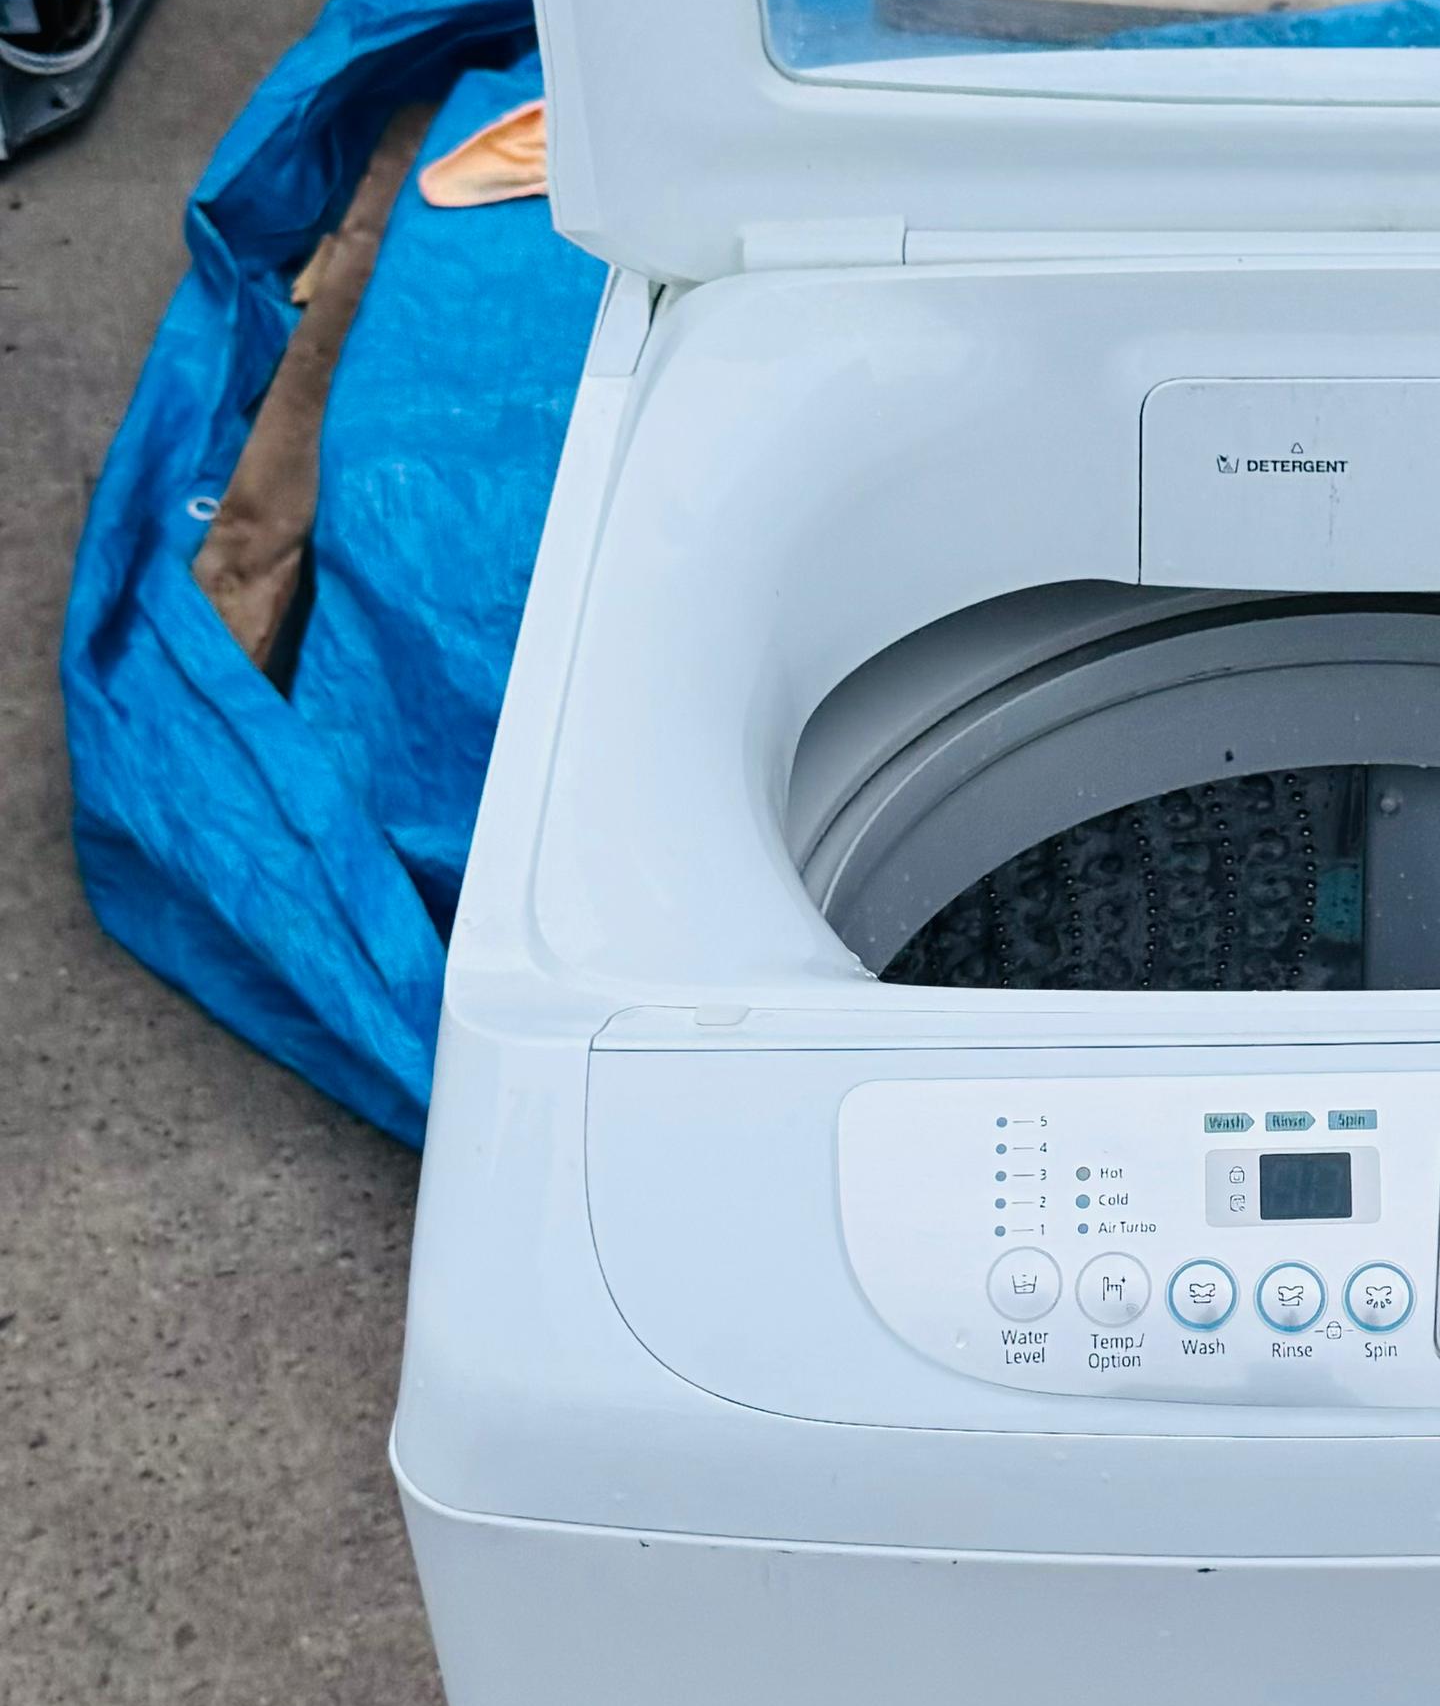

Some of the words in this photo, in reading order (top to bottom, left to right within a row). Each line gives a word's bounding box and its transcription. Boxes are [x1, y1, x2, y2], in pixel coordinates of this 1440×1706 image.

[1246, 459, 1349, 473] DETERGENT
[1040, 1115, 1048, 1128] 5
[1209, 1115, 1245, 1129] Wash
[1338, 1114, 1366, 1127] Spin
[1038, 1141, 1048, 1155] 4
[1040, 1168, 1047, 1181] 3
[1100, 1167, 1123, 1179] Hot
[1039, 1195, 1046, 1209] 2
[1098, 1192, 1129, 1206] Cold
[1098, 1222, 1117, 1234] Air
[1119, 1221, 1157, 1233] Turbo
[1001, 1329, 1049, 1346] Water
[1181, 1338, 1225, 1355] Wash
[1272, 1341, 1313, 1358] Rinse
[1364, 1341, 1398, 1362] Spin
[1005, 1346, 1045, 1365] Level
[1088, 1352, 1141, 1373] Option
